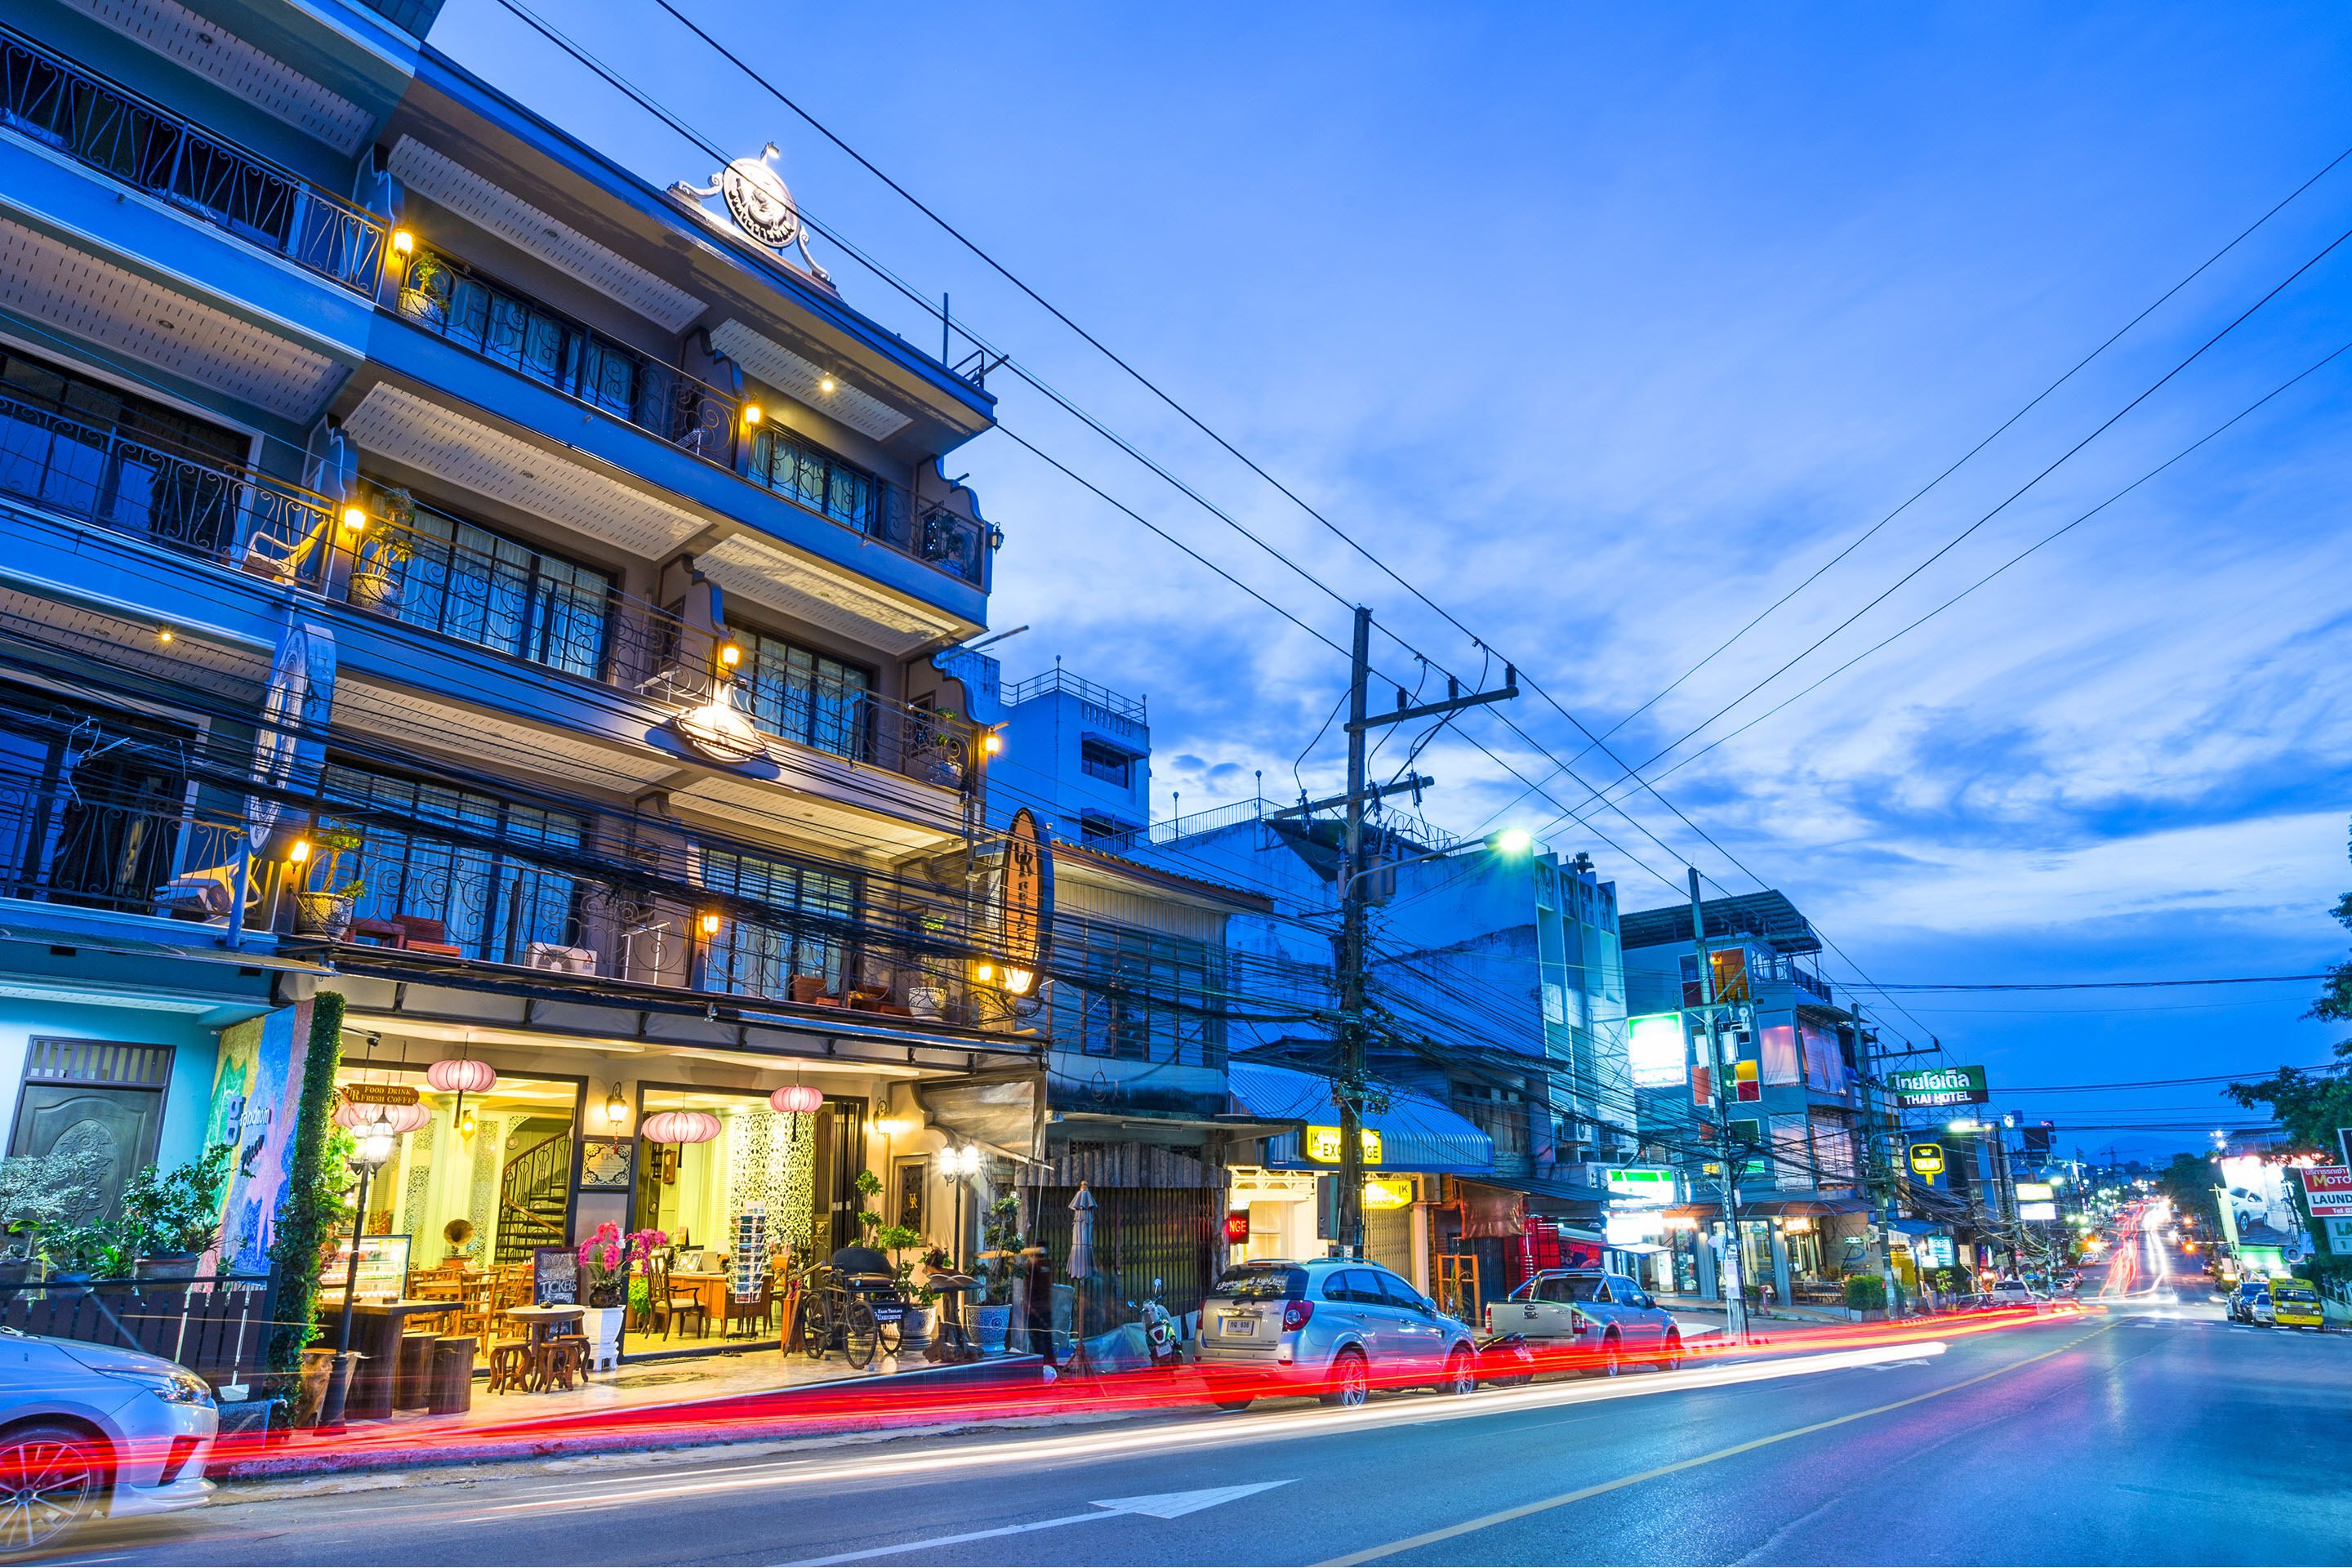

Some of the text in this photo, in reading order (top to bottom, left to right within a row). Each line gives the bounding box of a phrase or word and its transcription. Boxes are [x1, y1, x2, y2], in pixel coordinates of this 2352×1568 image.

[364, 1086, 411, 1095] FOOD DRINK
[361, 1094, 417, 1104] FRESH COFFEE
[1904, 1091, 1972, 1105] THAI HOTEL
[540, 1280, 577, 1294] TICKETS
